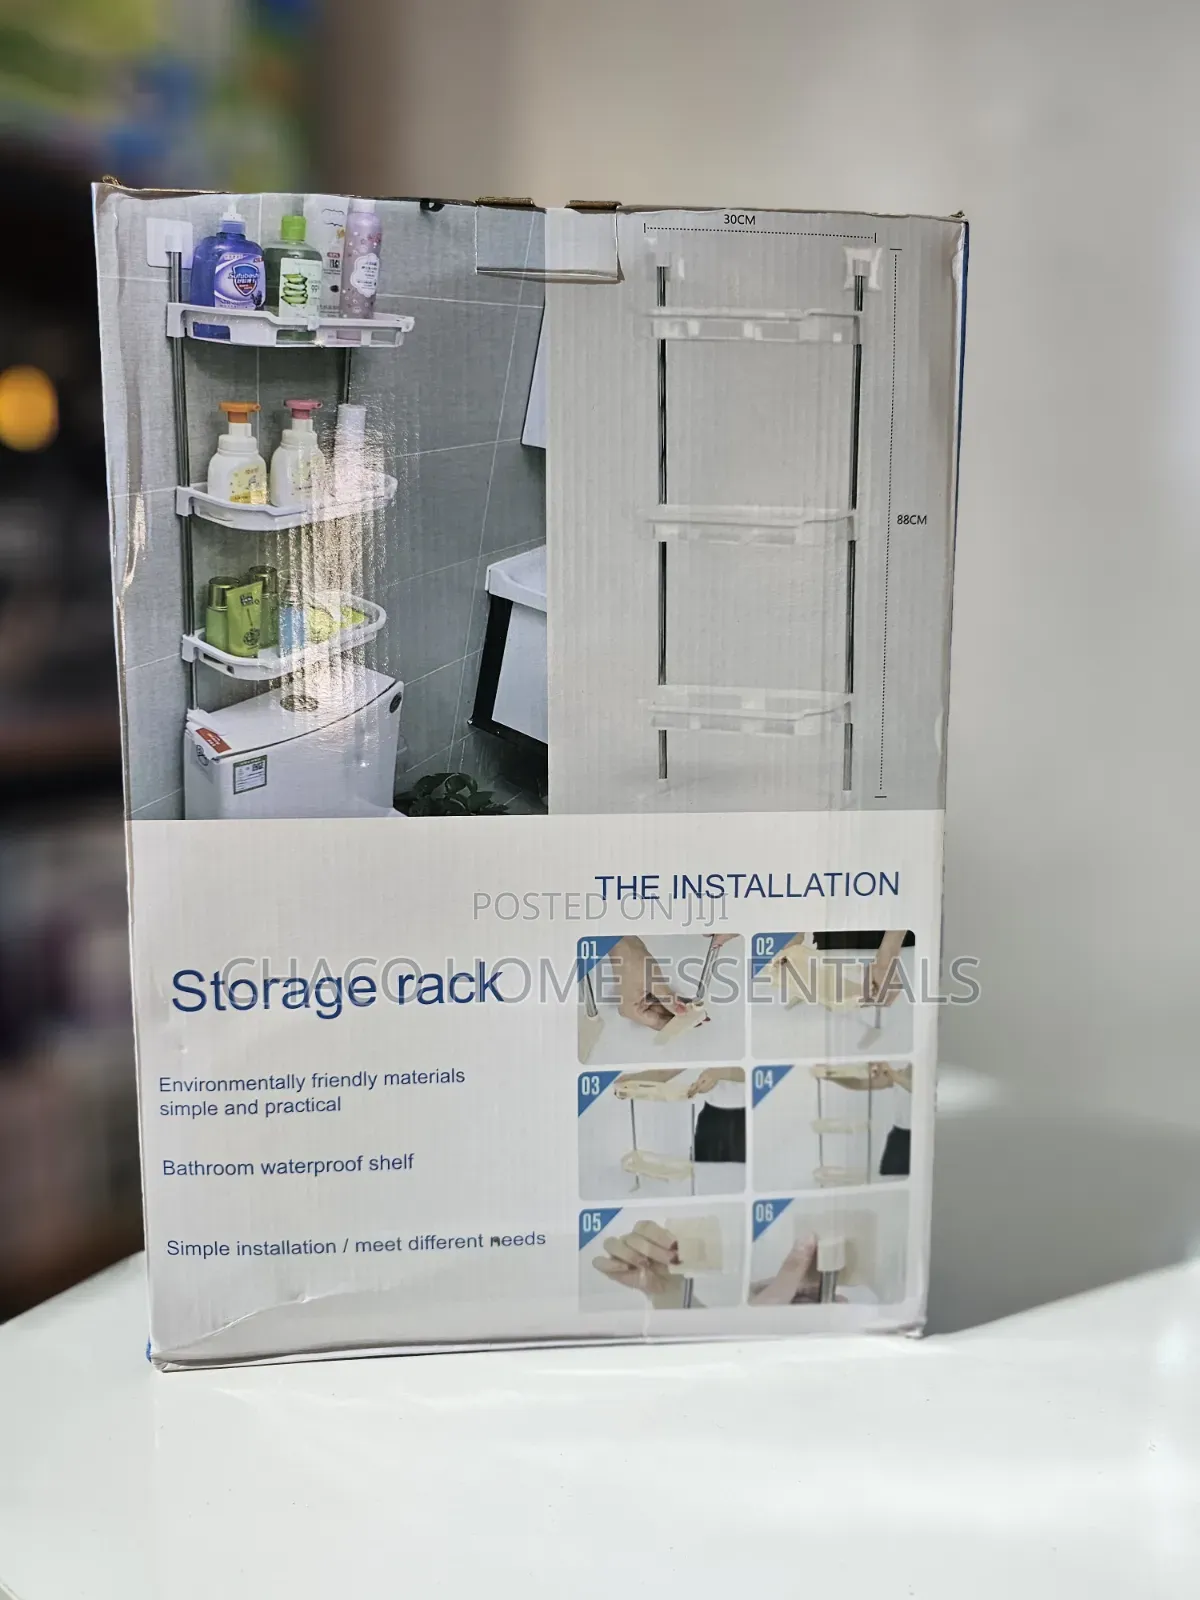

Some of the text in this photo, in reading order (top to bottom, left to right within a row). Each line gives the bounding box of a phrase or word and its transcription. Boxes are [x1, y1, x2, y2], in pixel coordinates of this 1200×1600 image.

[723, 214, 756, 225] 30CM
[896, 514, 927, 525] 88CM
[595, 871, 900, 900] THE INSTALLATION
[580, 940, 598, 960] 01
[756, 937, 774, 955] 02
[172, 961, 504, 1019] Storage rack
[159, 1068, 466, 1093] Environmentally friendly materials
[580, 1076, 600, 1096] 03
[755, 1071, 774, 1089] 04
[160, 1096, 341, 1119] simple and practical
[163, 1153, 415, 1177] Bathroom waterproof shelf
[582, 1212, 601, 1232] 05
[755, 1203, 774, 1223] 06
[167, 1240, 230, 1260] Simple
[236, 1238, 337, 1256] installation
[355, 1236, 402, 1253] meet
[408, 1234, 484, 1251] different
[490, 1231, 546, 1247] needs
